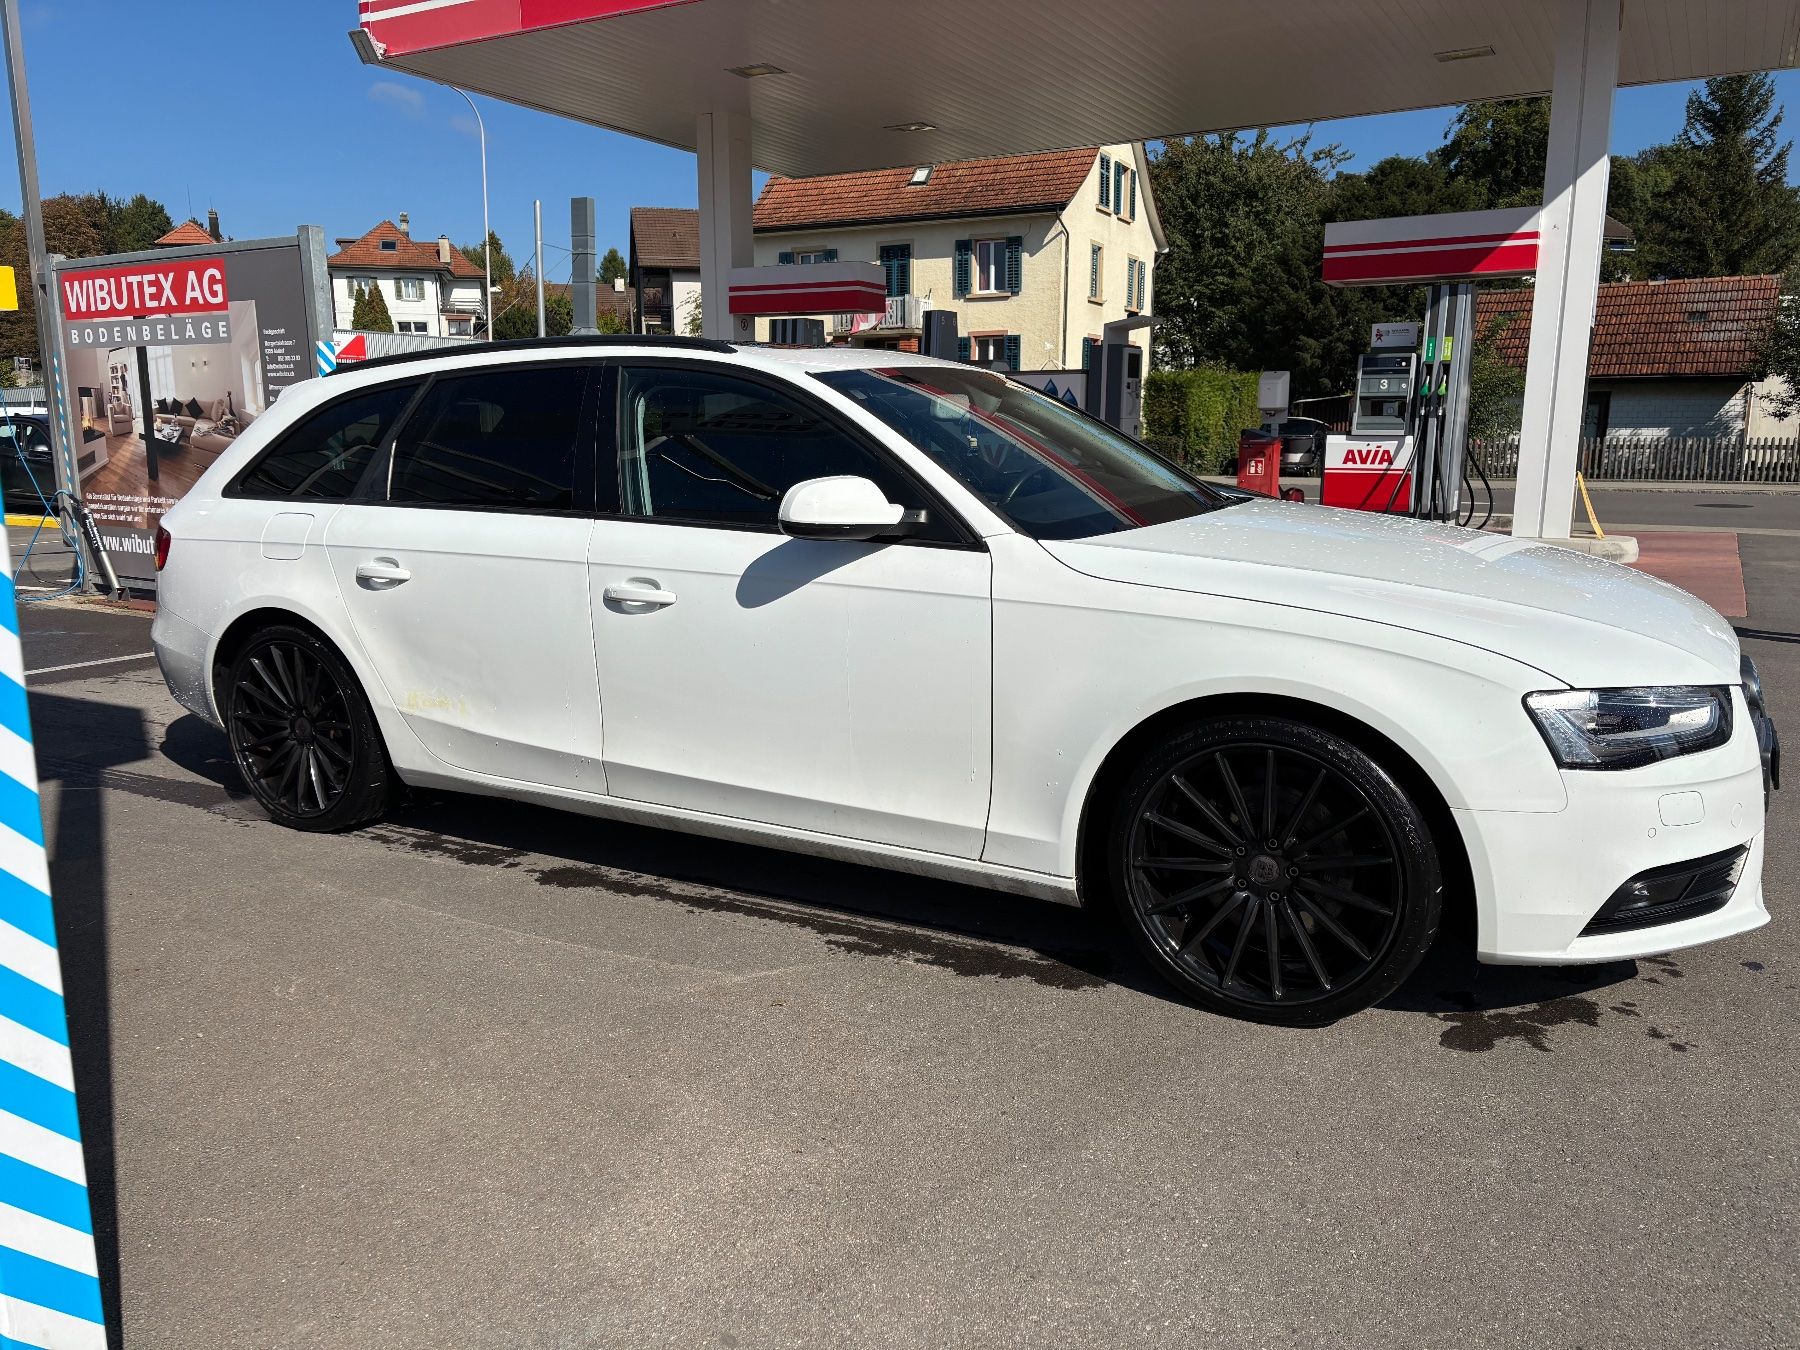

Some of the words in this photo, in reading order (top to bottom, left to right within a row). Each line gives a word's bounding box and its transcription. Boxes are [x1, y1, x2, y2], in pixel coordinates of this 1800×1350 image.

[65, 272, 179, 313] WIBUTEX
[185, 268, 224, 305] AG
[71, 319, 228, 344] BODENBELÄGE
[1380, 379, 1388, 390] 3
[102, 534, 155, 554] ww.wibut
